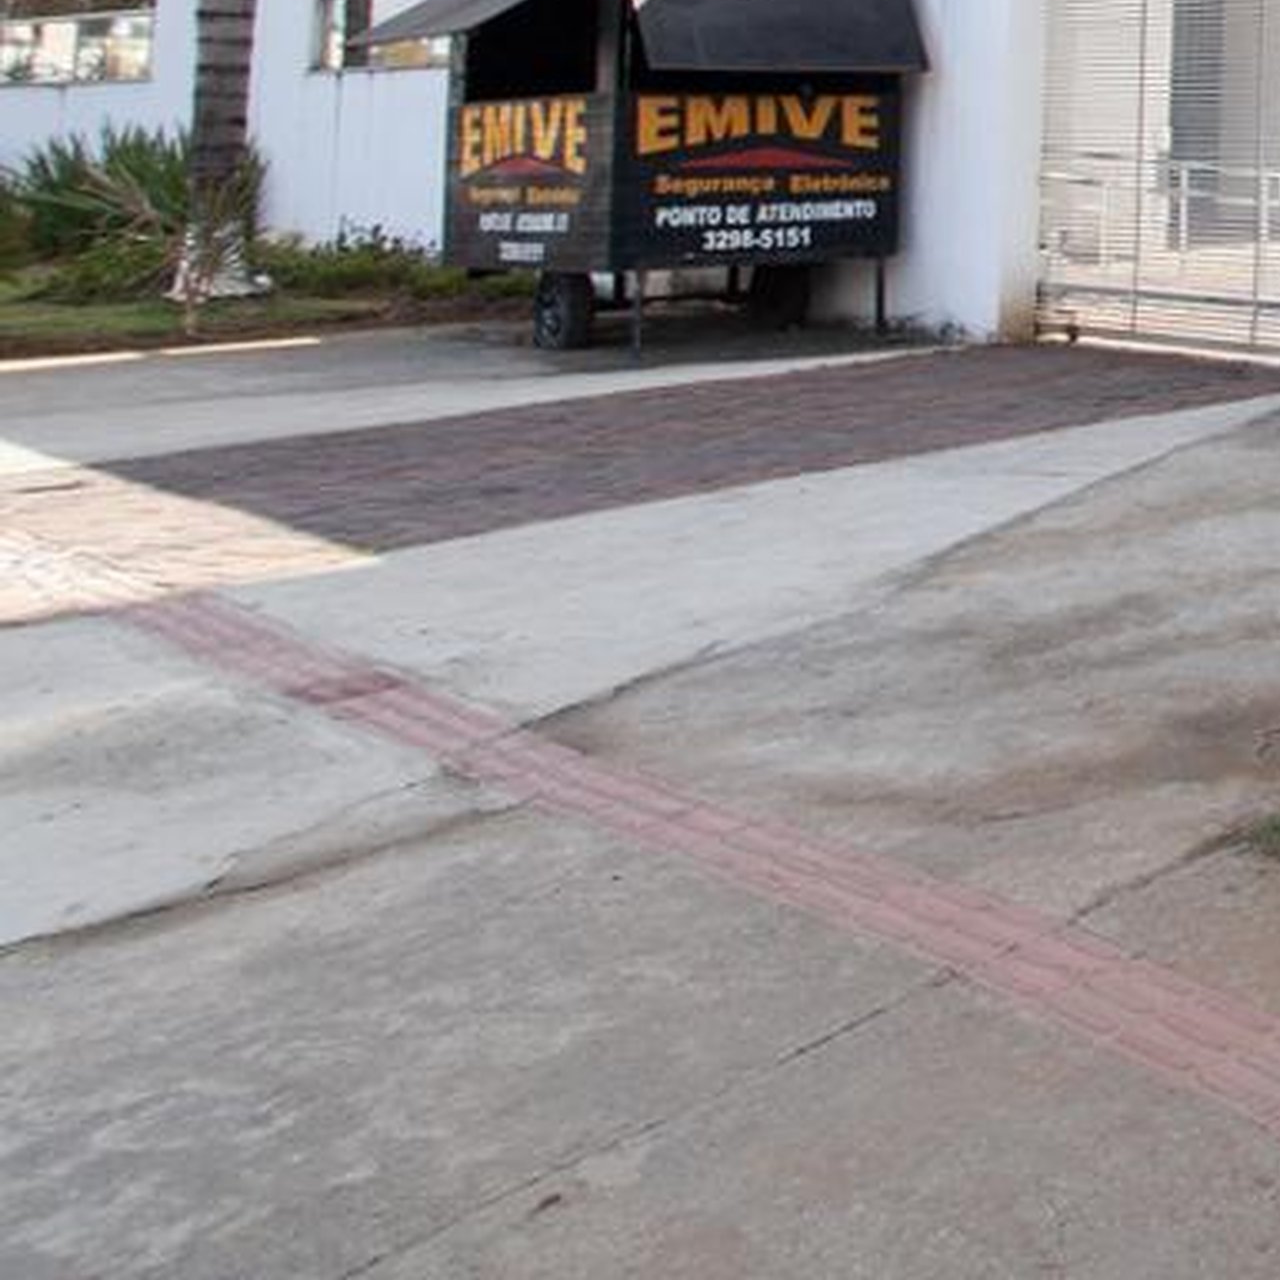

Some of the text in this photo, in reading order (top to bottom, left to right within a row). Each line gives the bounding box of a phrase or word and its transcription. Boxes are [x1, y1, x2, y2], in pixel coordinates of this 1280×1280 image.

[459, 96, 588, 177] EMIVE
[636, 93, 882, 154] EMIVE
[656, 200, 878, 228] PONTO DE ATENDIMENTO
